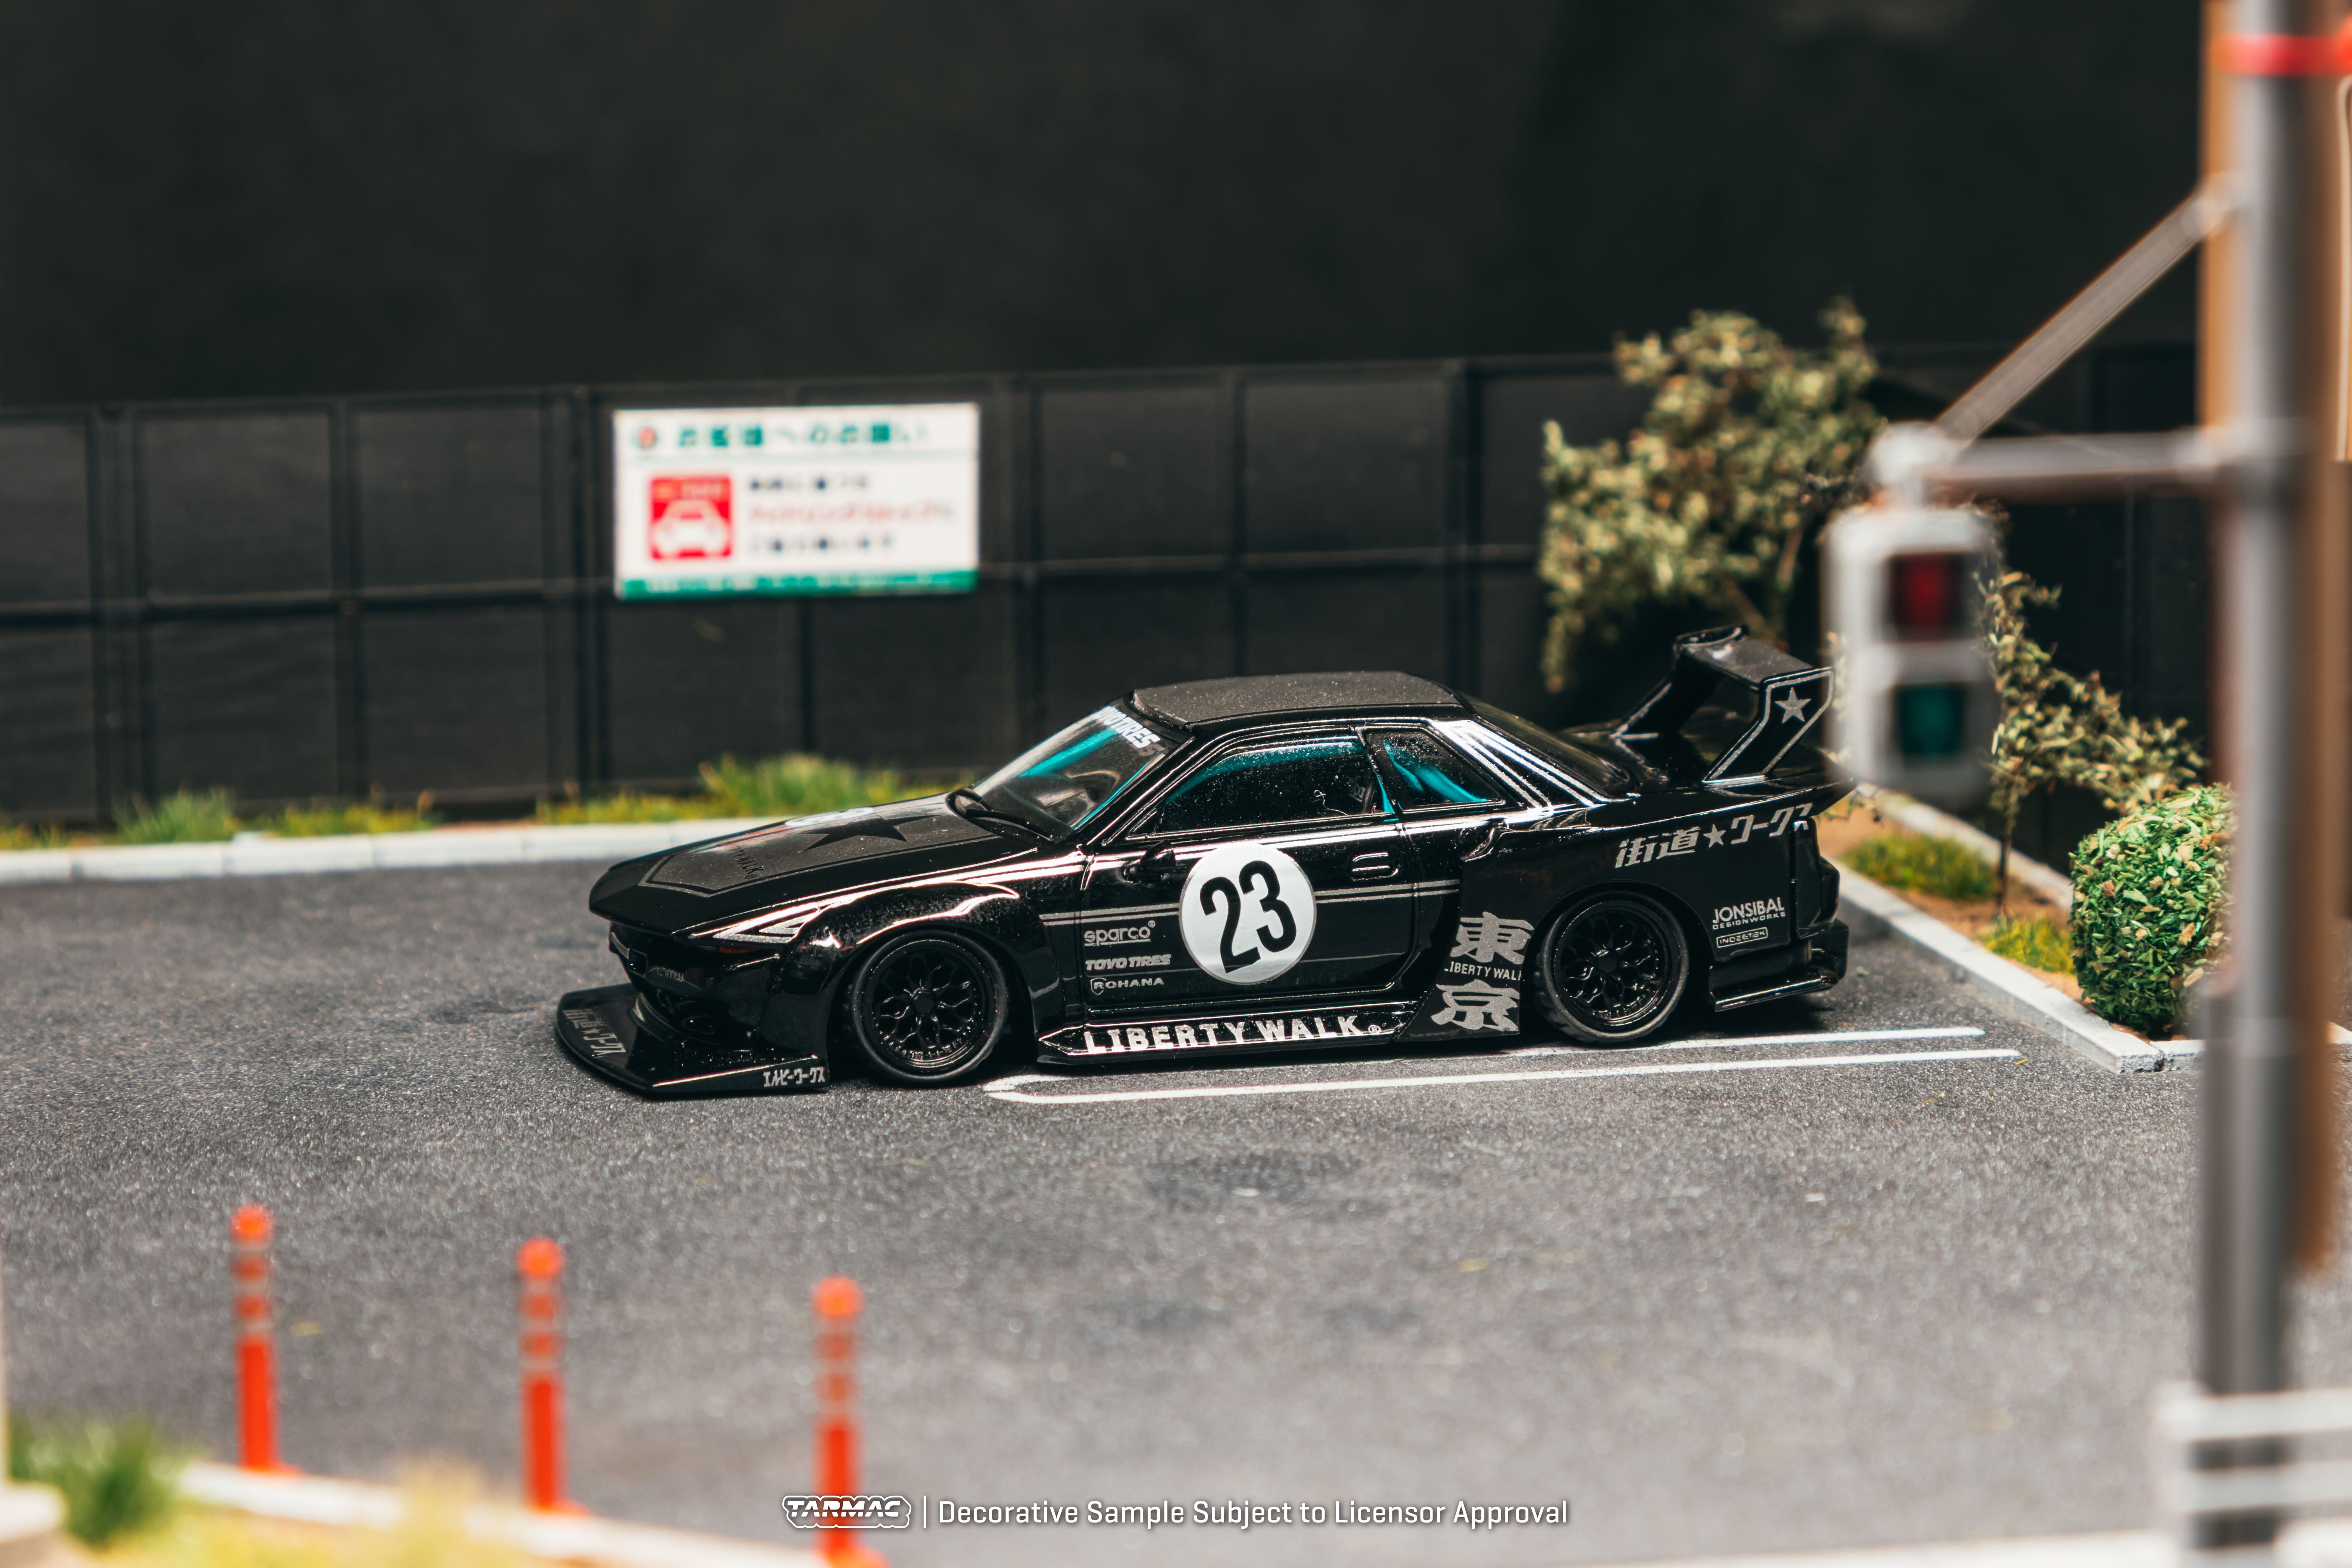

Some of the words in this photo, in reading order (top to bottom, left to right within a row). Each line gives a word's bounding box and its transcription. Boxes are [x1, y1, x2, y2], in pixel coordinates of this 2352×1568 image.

[1110, 717, 1161, 748] TIRES
[1200, 860, 1297, 974] 23
[1712, 897, 1785, 923] JONSIBAL
[1084, 926, 1151, 946] sparco
[1450, 912, 1534, 965] 東
[1085, 958, 1127, 971] TOYO
[1128, 954, 1172, 967] TIRES
[1093, 977, 1164, 990] ROHANA
[1431, 979, 1520, 1032] 京
[1083, 1021, 1245, 1054] LIBERTY
[1255, 1015, 1364, 1042] WALK
